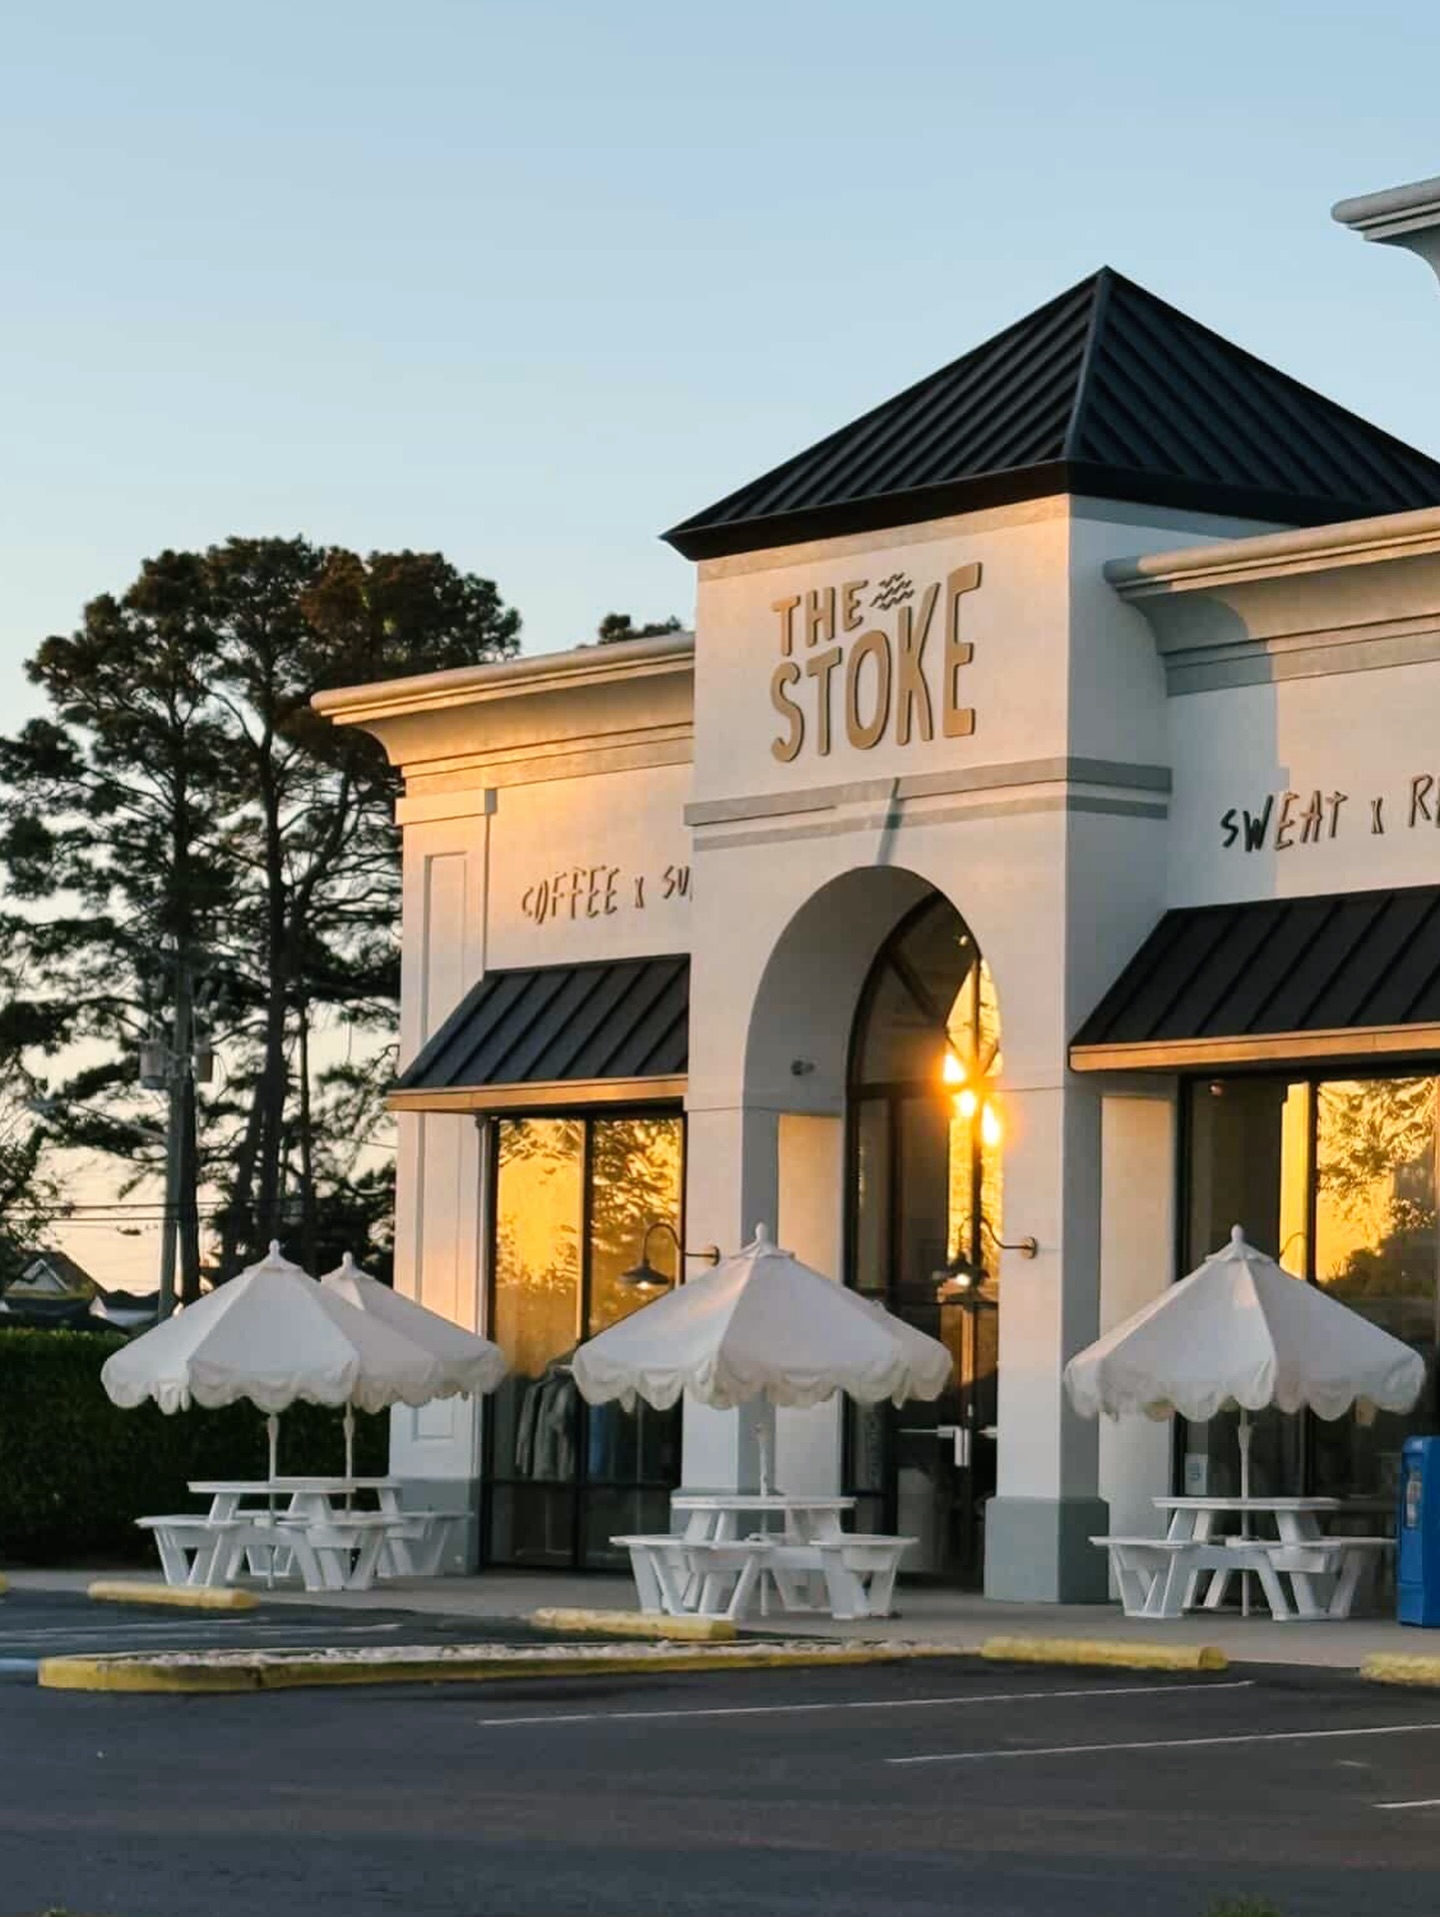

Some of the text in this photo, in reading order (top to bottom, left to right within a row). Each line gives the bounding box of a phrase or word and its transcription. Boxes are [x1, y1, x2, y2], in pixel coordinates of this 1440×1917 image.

[771, 580, 868, 656] THE
[770, 562, 982, 762] STOKE
[1220, 790, 1348, 852] SWEAT
[1408, 775, 1440, 828] R
[522, 865, 620, 924] COFFEE
[662, 865, 693, 901] SU
